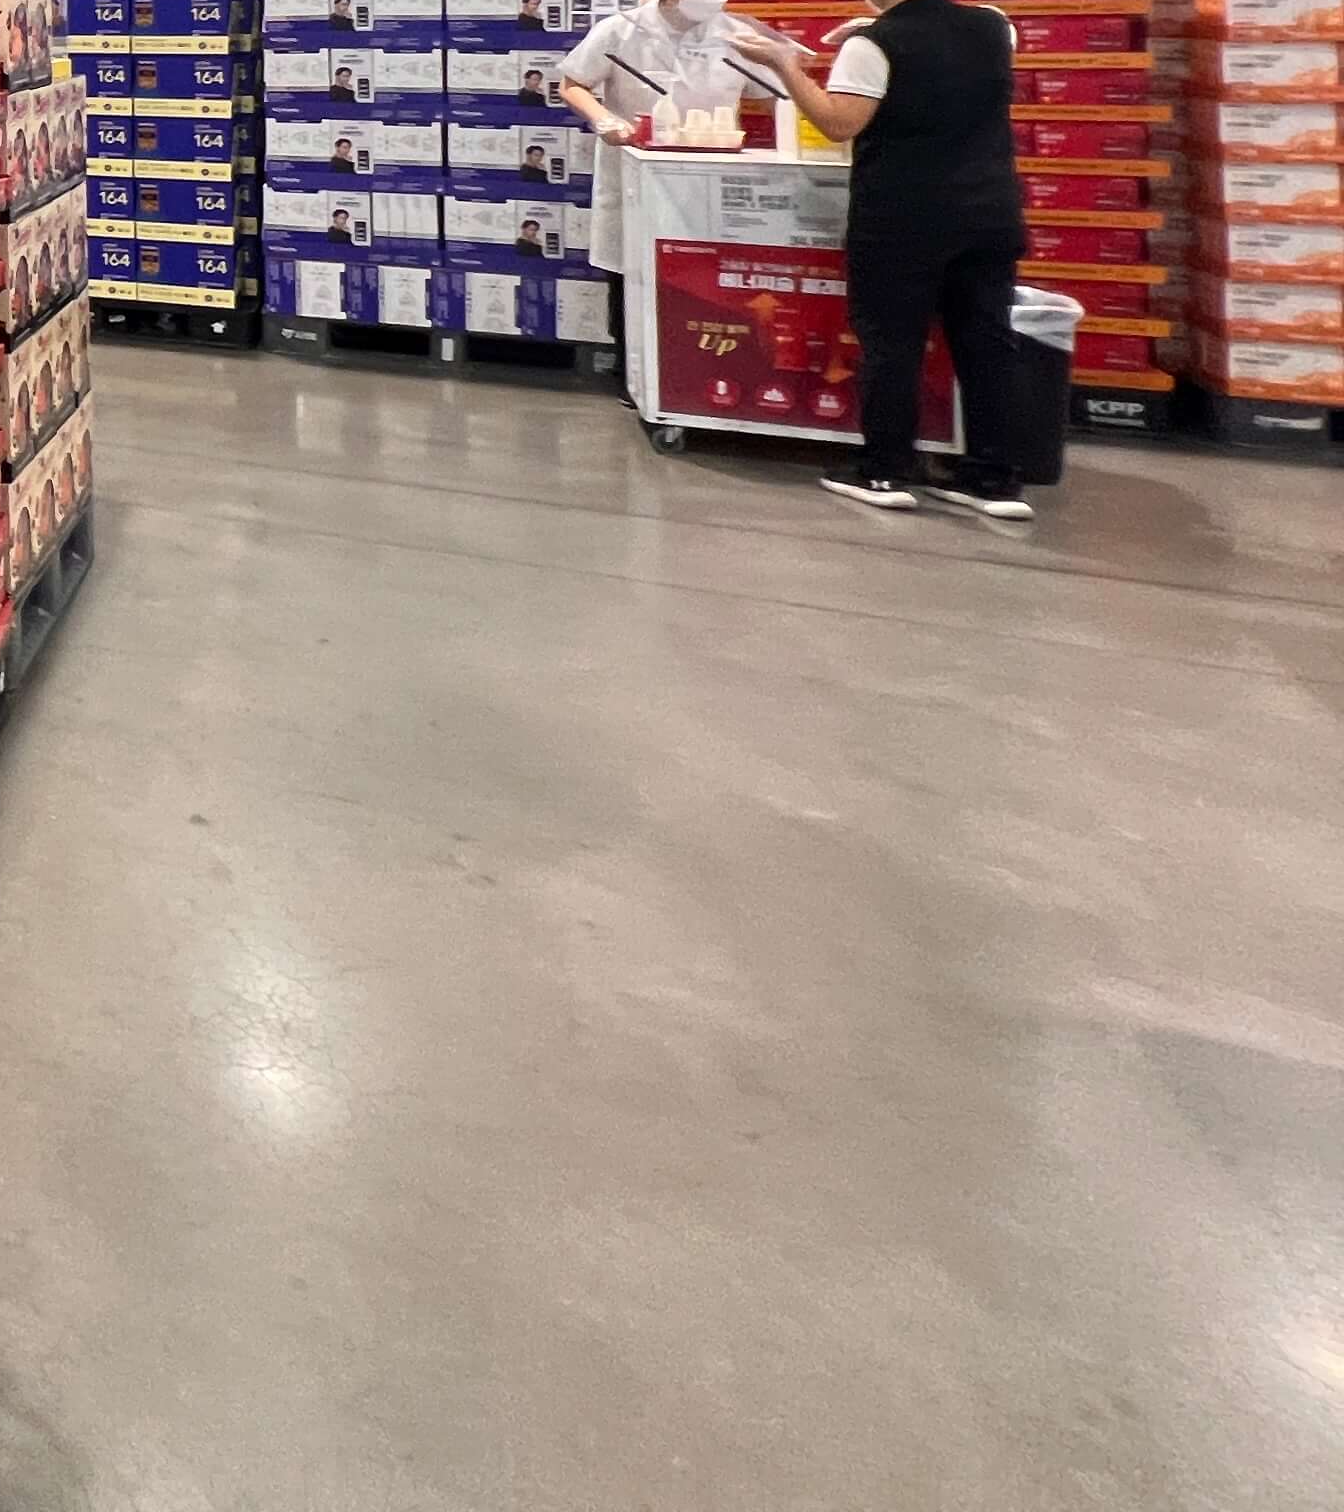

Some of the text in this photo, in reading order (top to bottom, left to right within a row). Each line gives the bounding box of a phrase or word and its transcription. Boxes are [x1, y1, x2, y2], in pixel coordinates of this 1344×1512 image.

[95, 7, 123, 22] 164
[191, 7, 221, 21] 164
[97, 70, 125, 84] 164
[194, 70, 224, 85] 164
[98, 130, 127, 145] 164
[194, 134, 224, 148] 164
[99, 191, 128, 205] 164
[196, 196, 226, 211] 164
[102, 252, 131, 267] 164
[198, 259, 228, 274] 164
[1086, 399, 1145, 417] KPP
